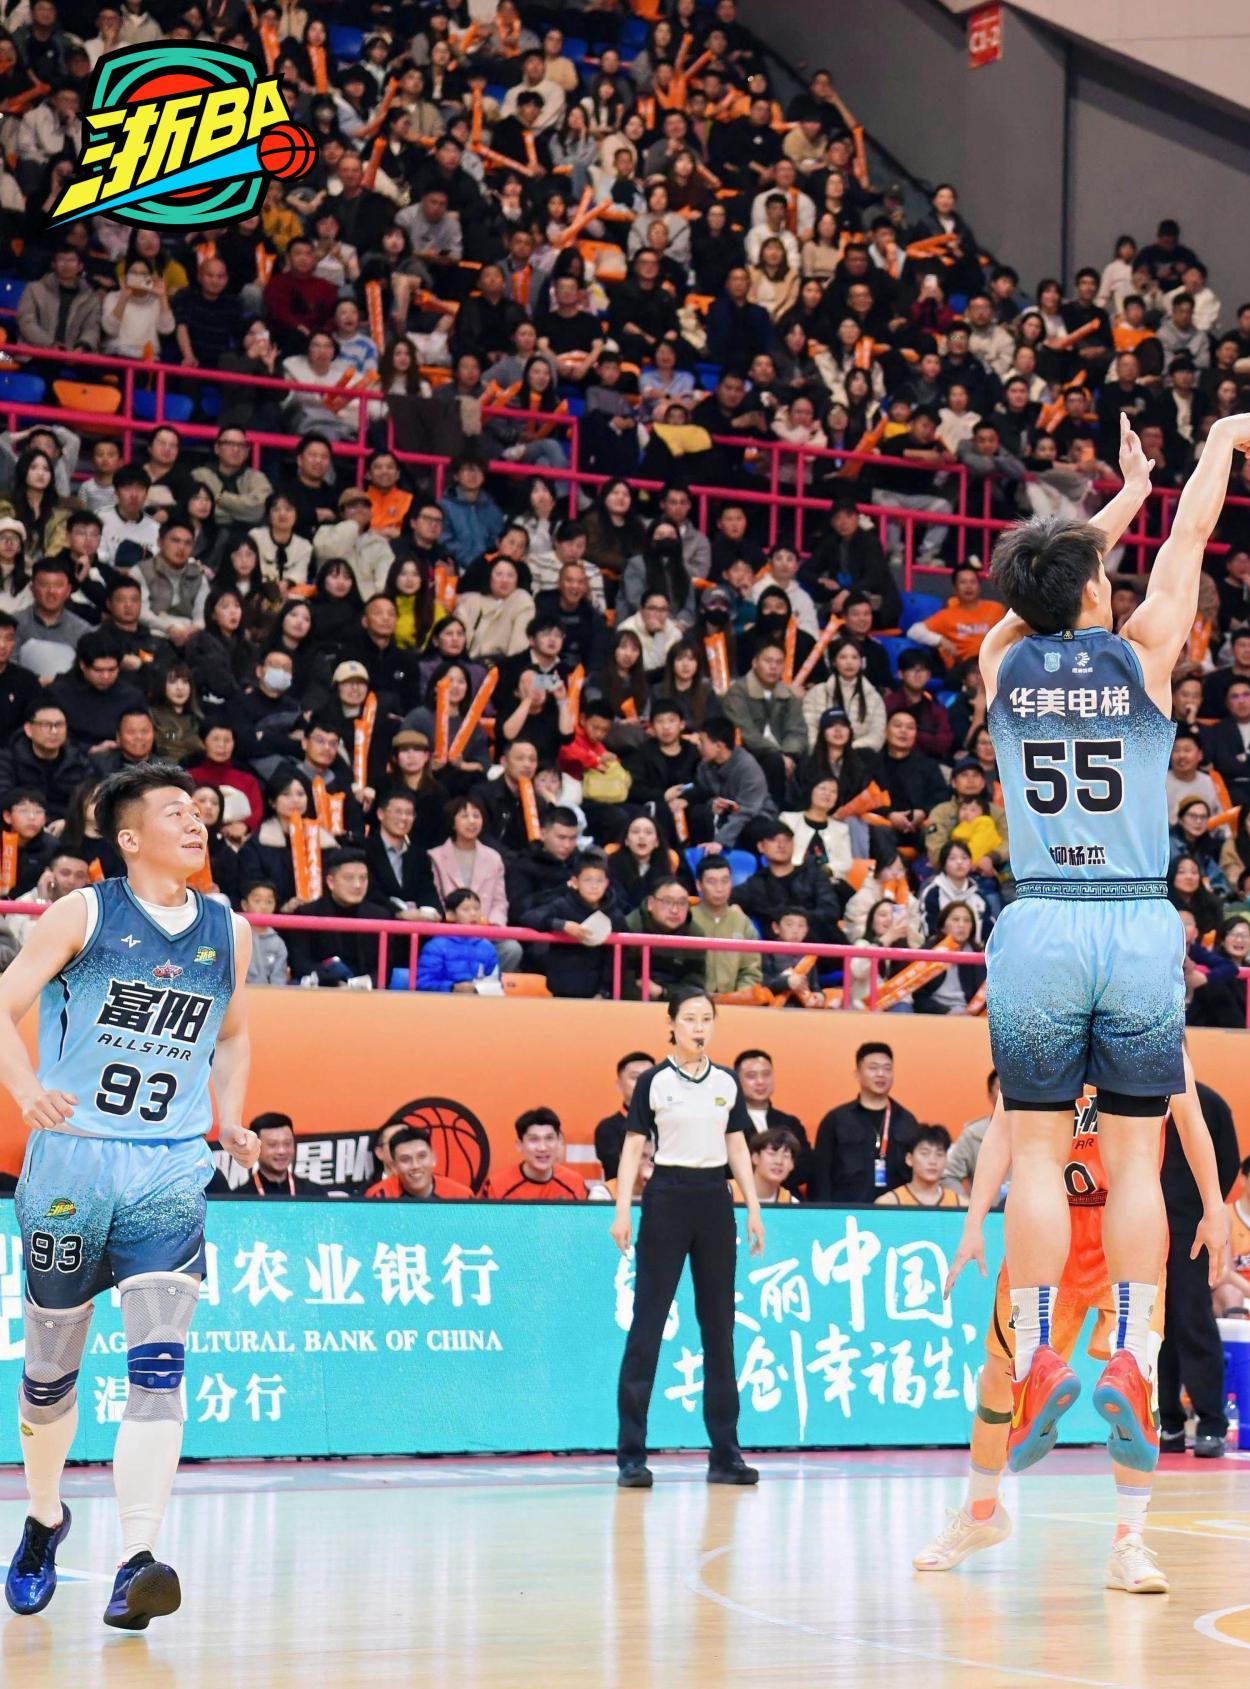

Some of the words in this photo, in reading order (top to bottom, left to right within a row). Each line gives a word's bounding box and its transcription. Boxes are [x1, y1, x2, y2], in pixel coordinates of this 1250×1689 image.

[1009, 685, 1131, 718] 华美电梯
[1021, 737, 1125, 817] 55
[95, 976, 215, 1046] 富阳
[96, 1032, 193, 1062] ALLSTAR
[94, 1061, 178, 1123] 93
[30, 1229, 84, 1274] 93
[205, 1240, 500, 1307] 农业银行
[305, 1330, 377, 1353] BANK
[385, 1330, 418, 1352] OF
[426, 1330, 503, 1352] CHINA
[94, 1372, 288, 1425] 温分行
